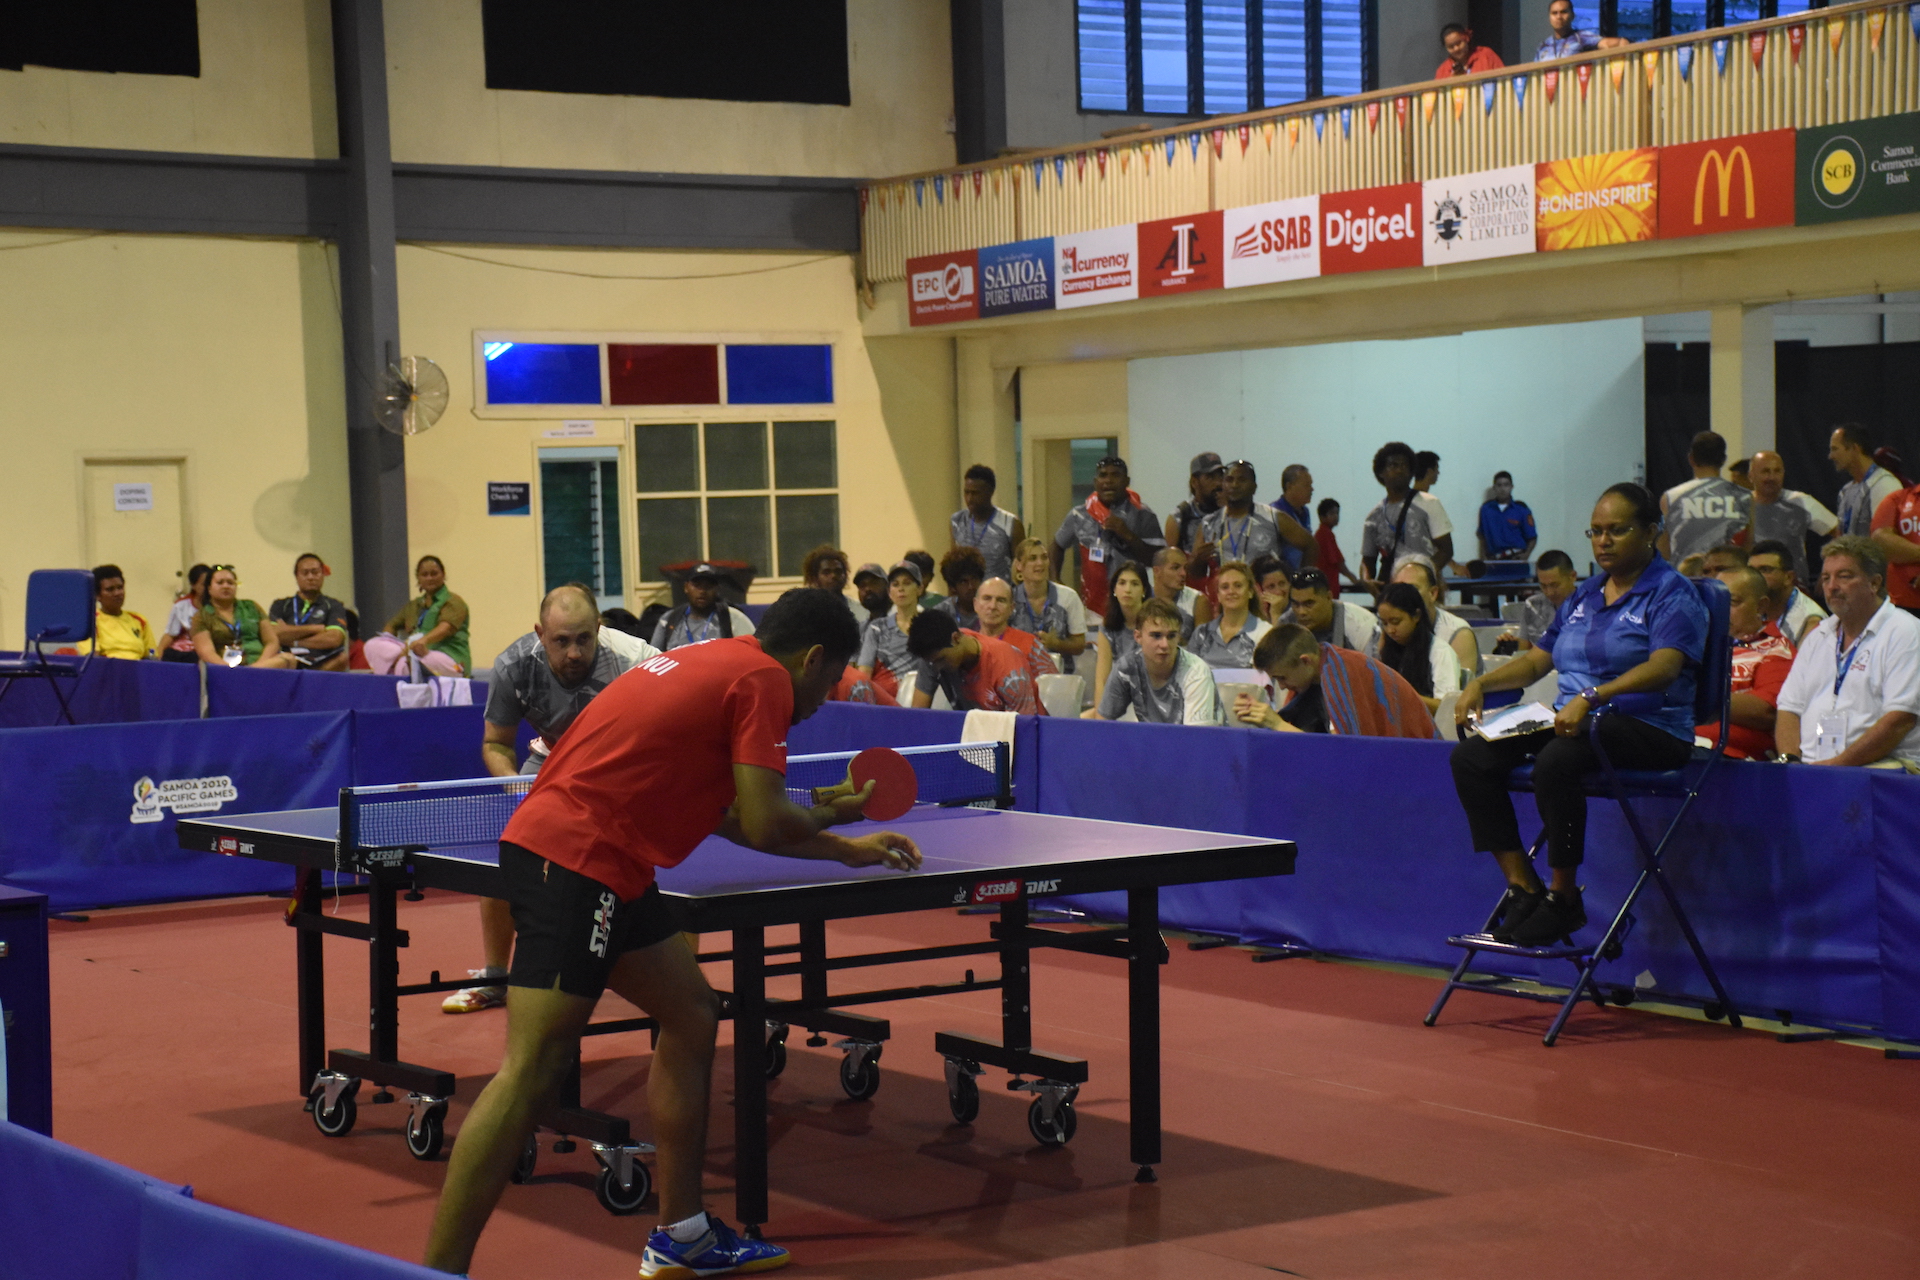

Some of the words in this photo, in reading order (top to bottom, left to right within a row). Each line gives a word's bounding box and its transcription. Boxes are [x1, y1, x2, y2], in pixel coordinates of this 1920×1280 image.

[1883, 145, 1914, 158] Samoa
[1825, 164, 1852, 180] SCB
[1871, 154, 1920, 172] Commercia
[1886, 170, 1910, 185] Bank
[1470, 183, 1528, 204] SAMOA
[1539, 183, 1653, 215] #ONEINSPIRIT
[1469, 196, 1529, 216] SHIPPING
[1326, 203, 1415, 253] Digicel
[1469, 210, 1529, 229] CORPORATION
[1261, 215, 1311, 254] SSAB
[1470, 223, 1529, 241] LIMITED
[1077, 253, 1130, 272] currency
[984, 258, 1047, 290] SAMOA
[1062, 279, 1095, 292] Currency
[1095, 274, 1130, 287] Exchange
[917, 277, 939, 294] EPC
[985, 288, 1010, 307] PURE
[1011, 283, 1048, 303] WATER
[1681, 495, 1740, 519] NCL
[162, 782, 199, 793] SAMOA
[201, 779, 228, 789] 2019
[158, 793, 196, 804] PACIFIC
[199, 789, 234, 800] GAMES
[1025, 879, 1061, 894] DHS
[589, 891, 616, 958] STAG
